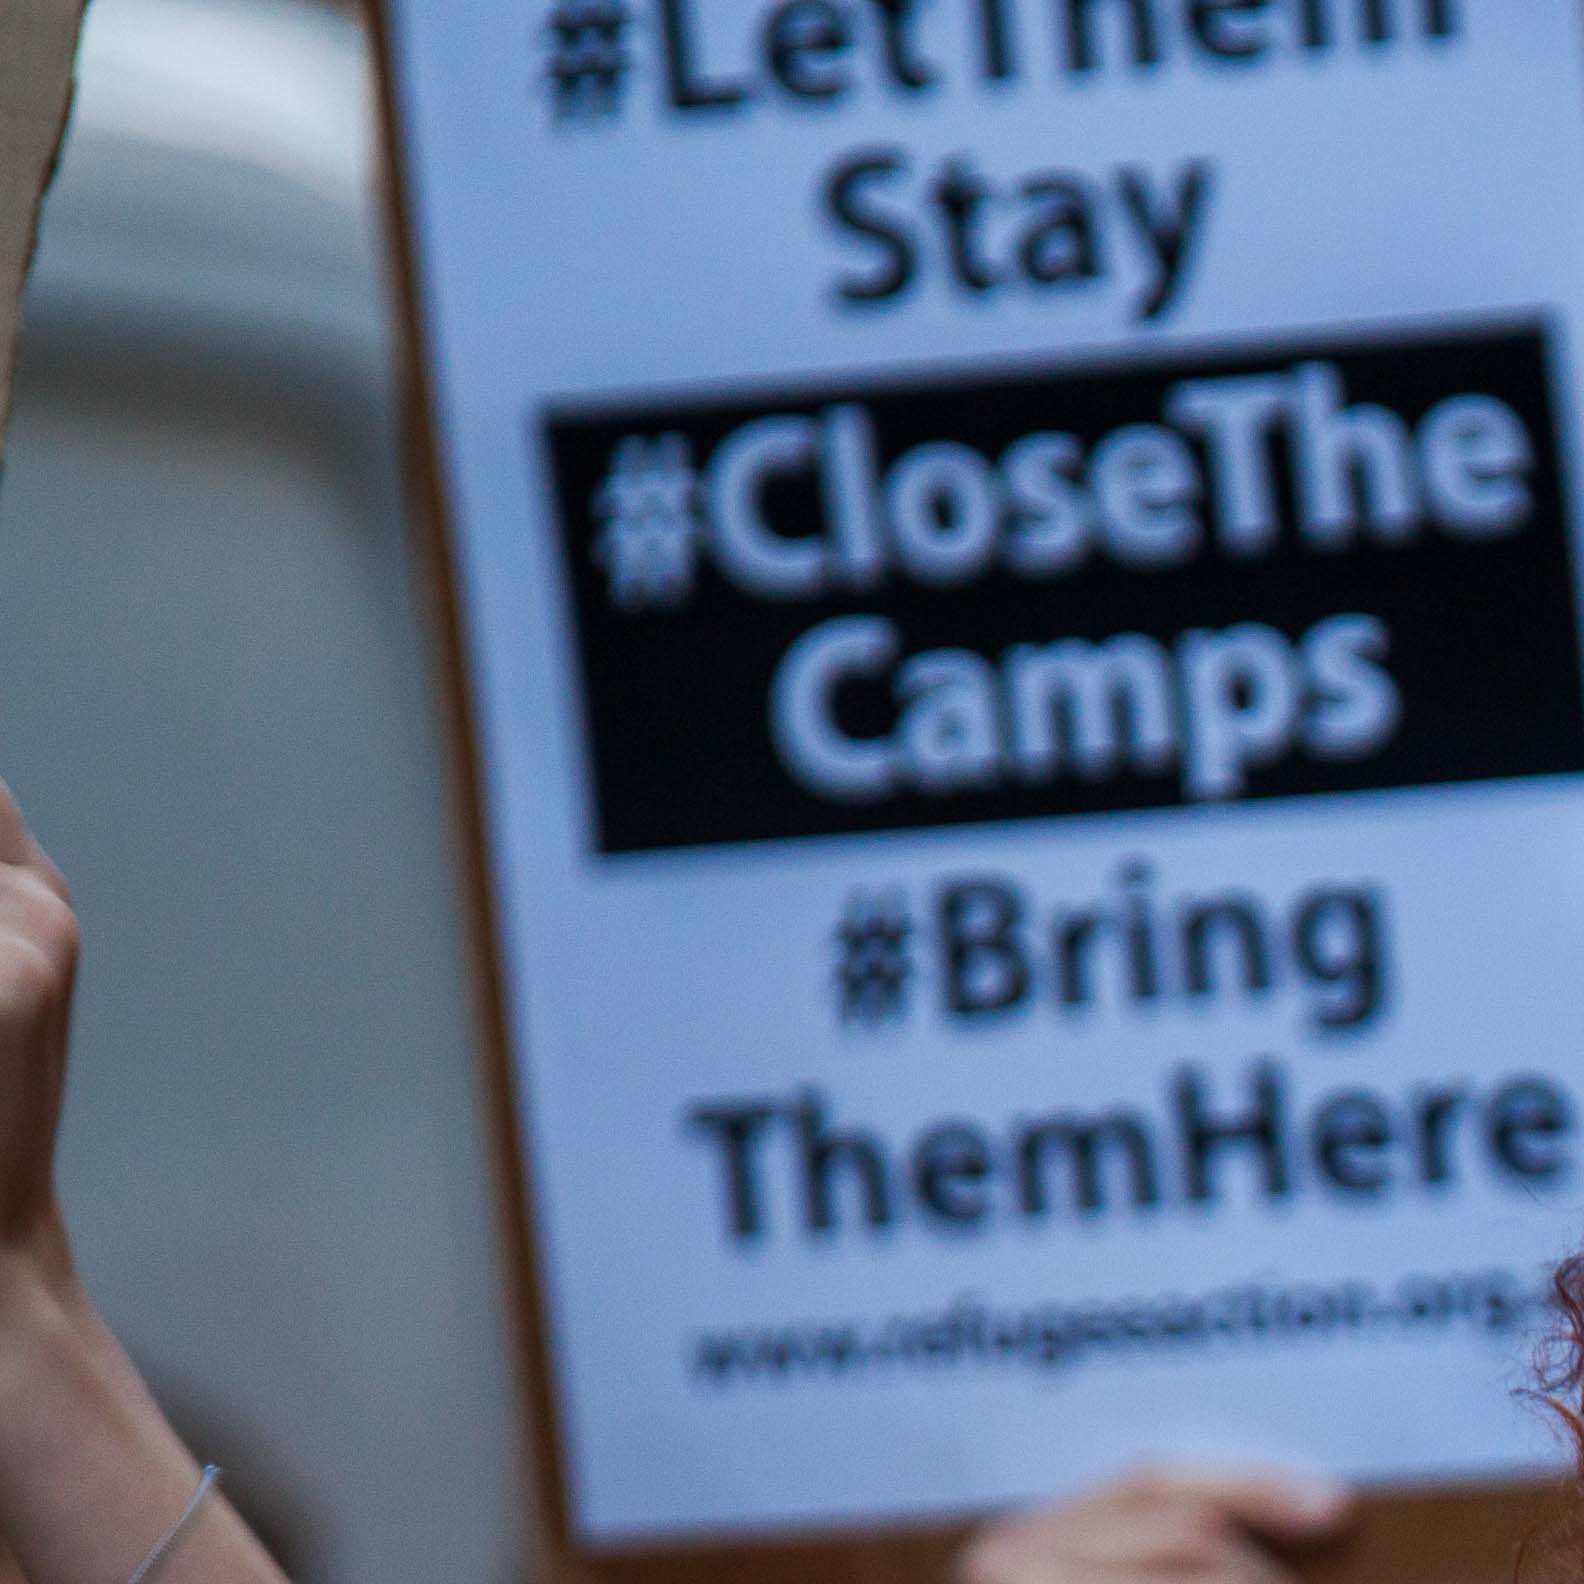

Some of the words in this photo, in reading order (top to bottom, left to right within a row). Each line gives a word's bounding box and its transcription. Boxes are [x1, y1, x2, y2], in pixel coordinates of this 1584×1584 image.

[818, 143, 1214, 322] Stay
[600, 362, 1532, 604] #CloseThe
[772, 614, 1398, 798] Camps
[832, 862, 1394, 1034] #Bring
[684, 1060, 1578, 1256] ThemHere
